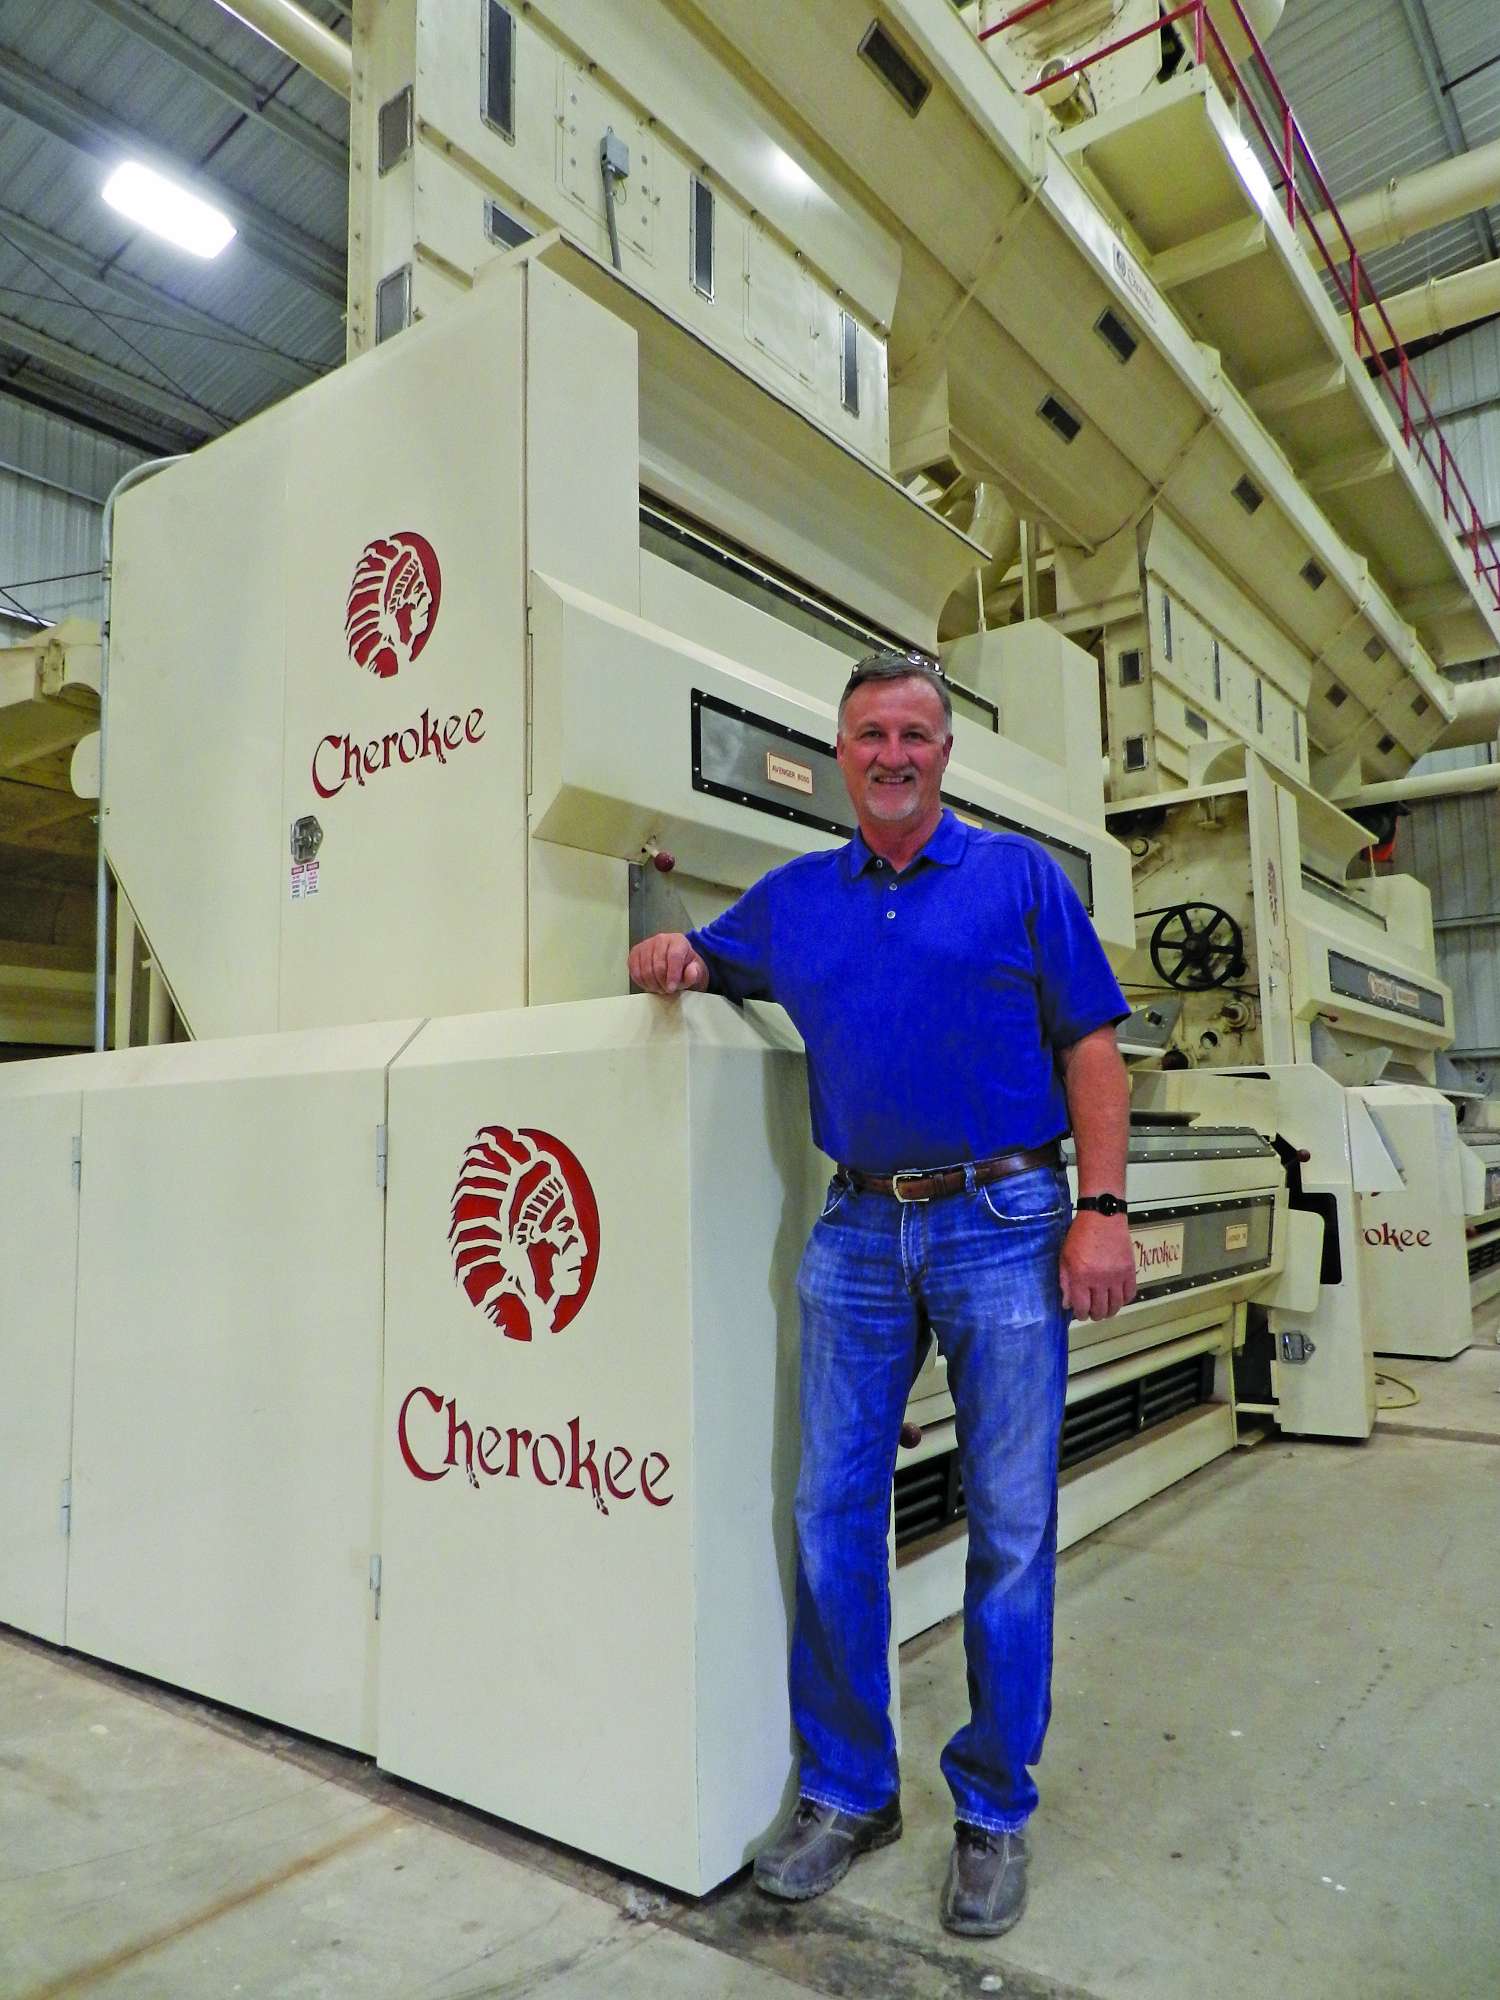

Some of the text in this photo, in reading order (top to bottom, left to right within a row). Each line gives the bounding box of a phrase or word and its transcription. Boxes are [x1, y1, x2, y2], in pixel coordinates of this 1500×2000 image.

[312, 707, 486, 799] Cherokee
[1362, 1222, 1433, 1252] okee
[399, 1386, 674, 1516] Cherokee
